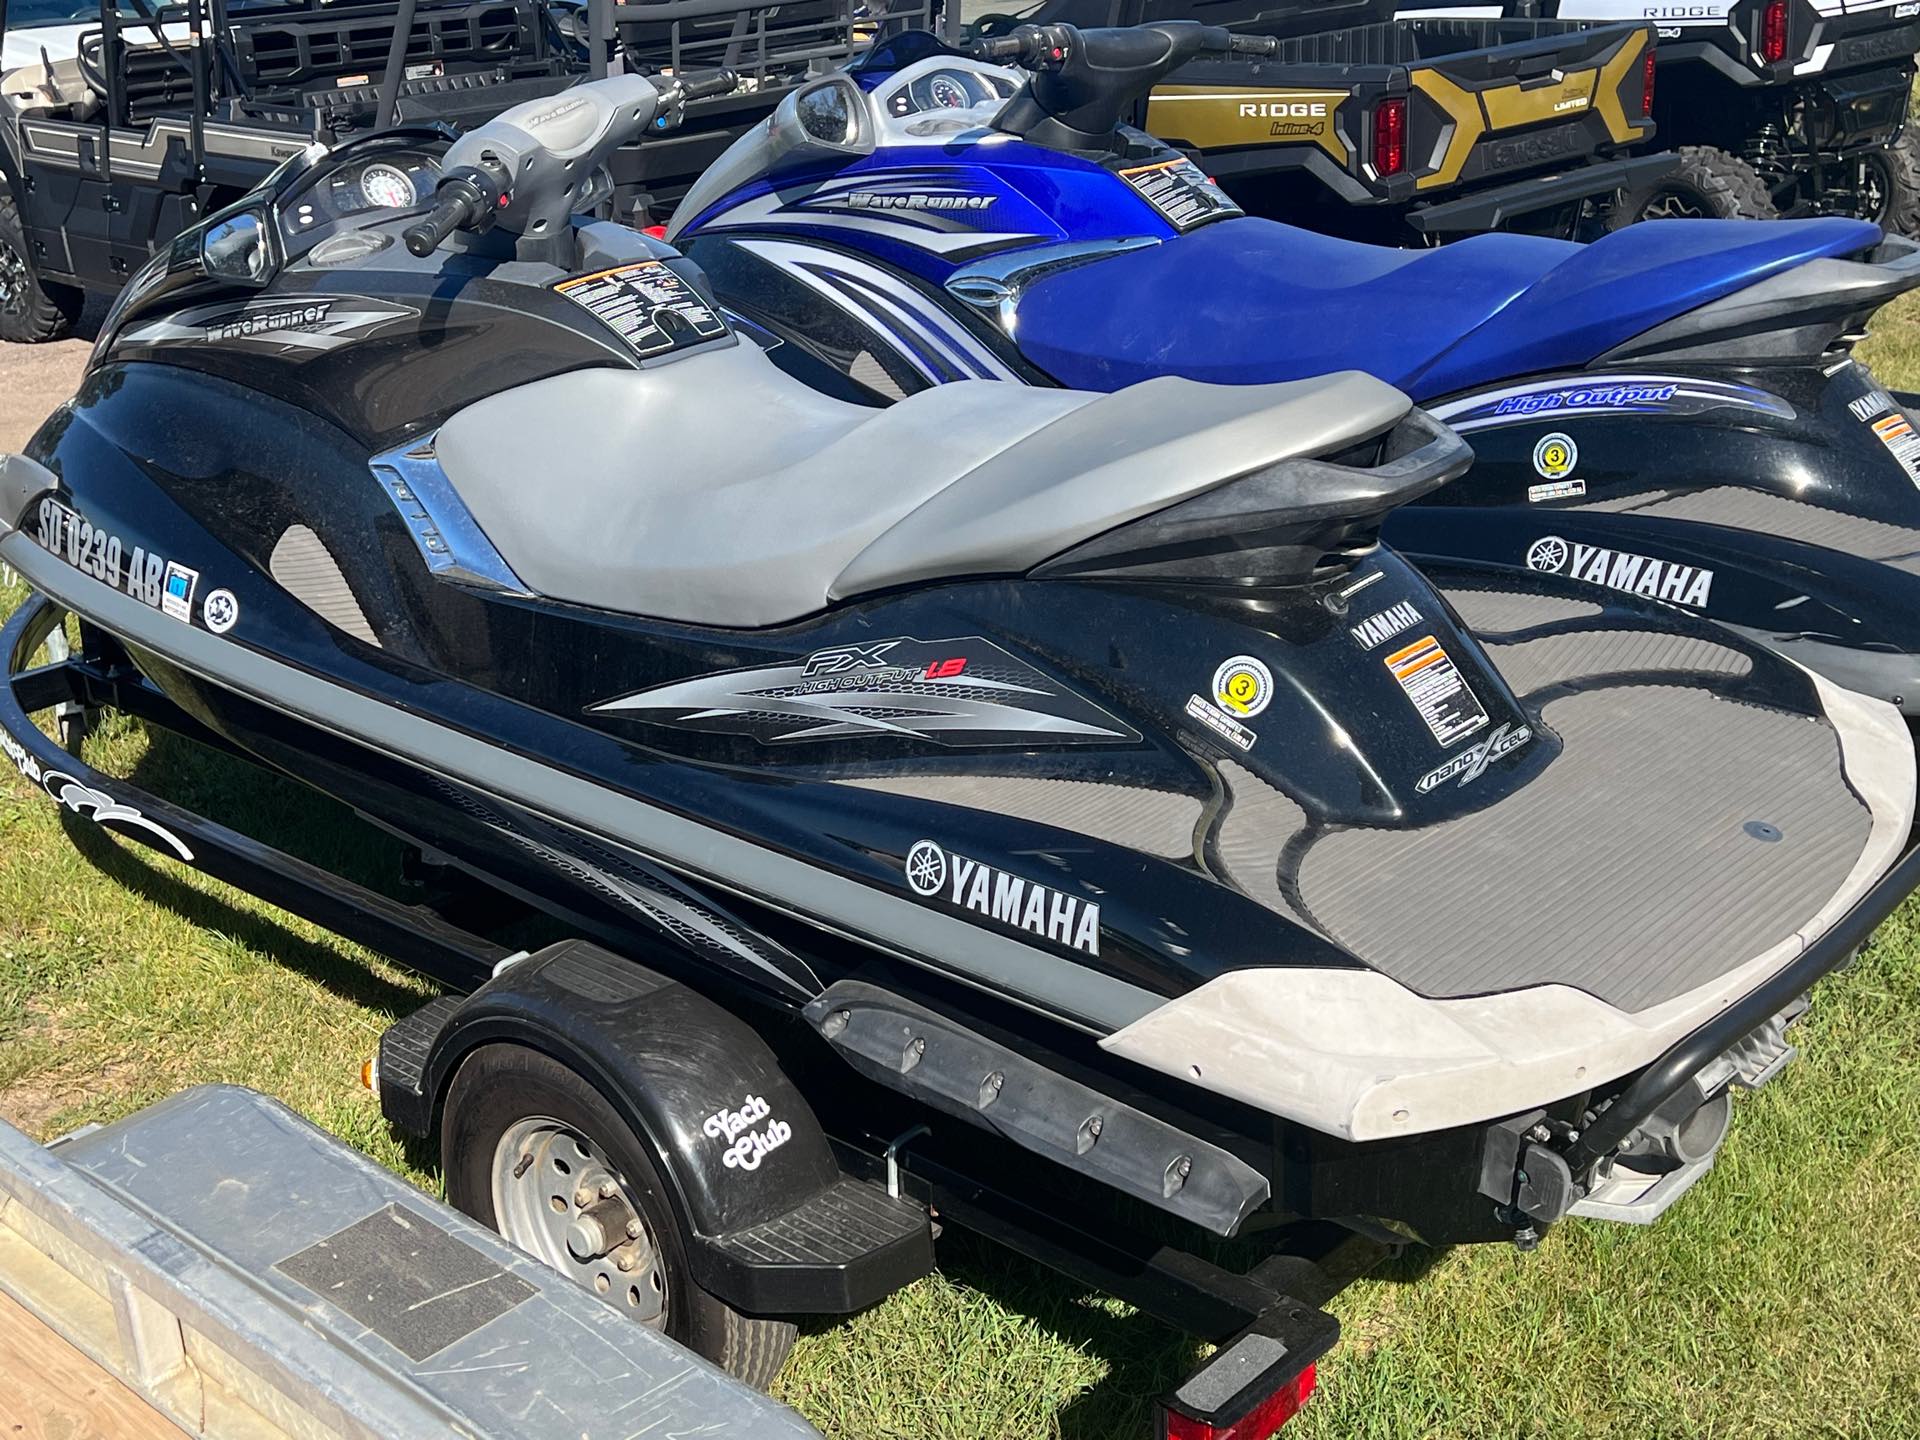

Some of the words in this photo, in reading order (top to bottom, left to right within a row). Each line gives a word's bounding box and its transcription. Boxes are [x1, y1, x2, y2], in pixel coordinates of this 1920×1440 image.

[1643, 6, 1720, 17] RIDGE
[1240, 103, 1327, 117] RIDGE
[1270, 121, 1325, 136] Inline-4
[848, 192, 998, 209] WaveRunner
[205, 302, 332, 343] WaveRunner
[1494, 393, 1565, 415] High
[1566, 384, 1681, 407] Output
[1550, 450, 1560, 463] 3
[38, 498, 63, 556] SD
[67, 516, 122, 588] 0239
[128, 546, 164, 607] AB
[1570, 544, 1714, 609] YAMAHA
[1351, 600, 1424, 648] YAMAHA
[802, 641, 902, 676] FX
[799, 678, 840, 693] HIGH
[840, 667, 922, 689] OUTPUT
[1235, 680, 1250, 696] 3
[951, 853, 1100, 958] YAMAHA
[722, 1118, 792, 1171] Club
